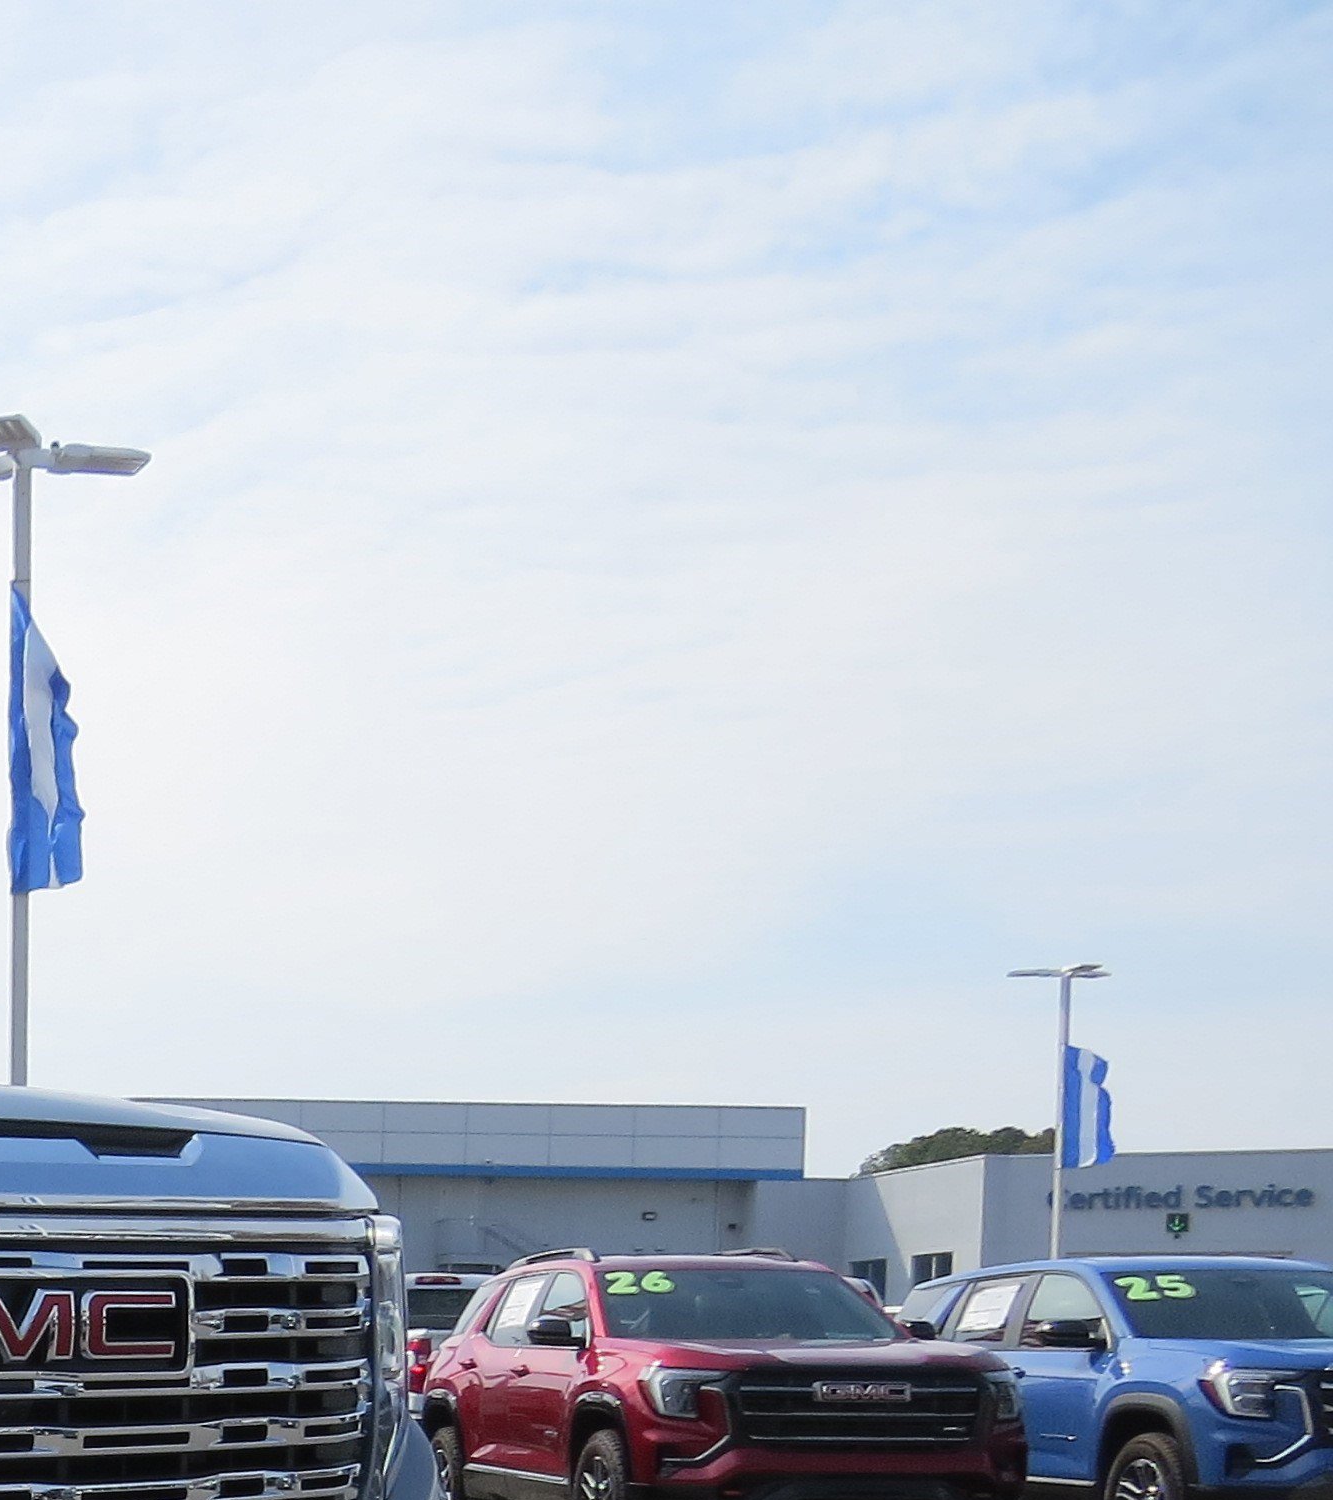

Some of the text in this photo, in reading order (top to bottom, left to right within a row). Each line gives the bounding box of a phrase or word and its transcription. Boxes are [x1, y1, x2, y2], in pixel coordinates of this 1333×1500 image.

[1194, 1184, 1315, 1208] Service
[604, 1271, 675, 1295] 26
[1114, 1274, 1196, 1301] 25
[821, 1384, 907, 1400] GMC
